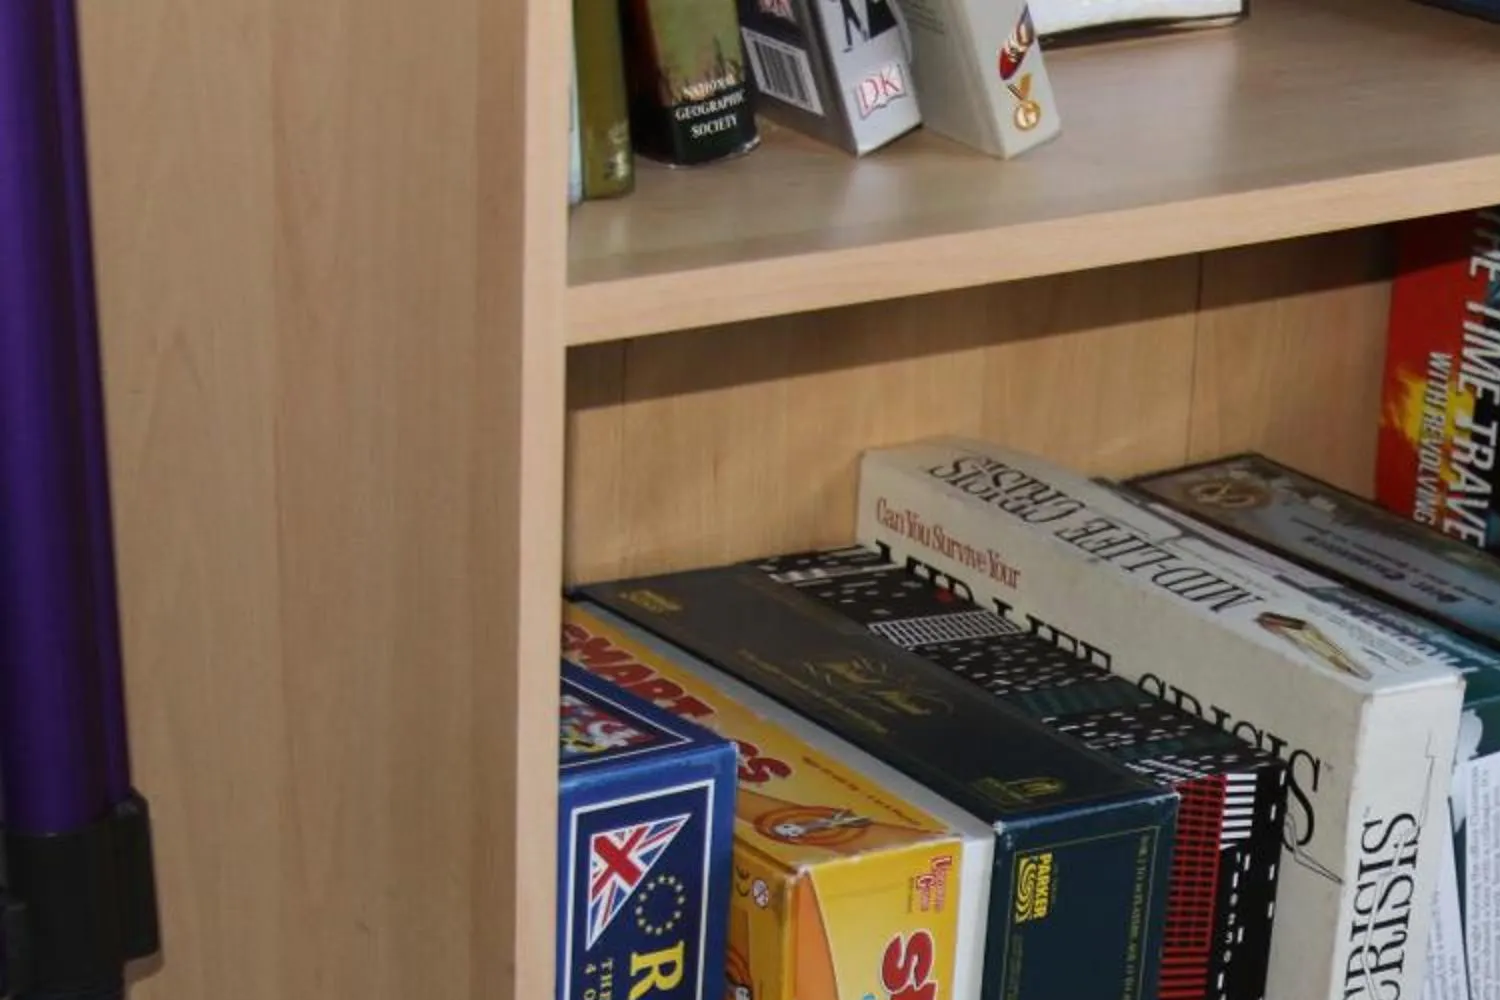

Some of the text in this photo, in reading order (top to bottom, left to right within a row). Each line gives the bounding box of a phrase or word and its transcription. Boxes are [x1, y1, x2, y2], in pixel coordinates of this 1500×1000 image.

[674, 88, 745, 121] GEOGRAPHIC
[858, 68, 902, 113] DK
[690, 113, 738, 139] SOCIETY
[1413, 351, 1452, 526] WITH REVOLVING
[876, 498, 1021, 589] Can You Survive Your
[1033, 852, 1053, 919] PARKER
[584, 962, 597, 977] 4
